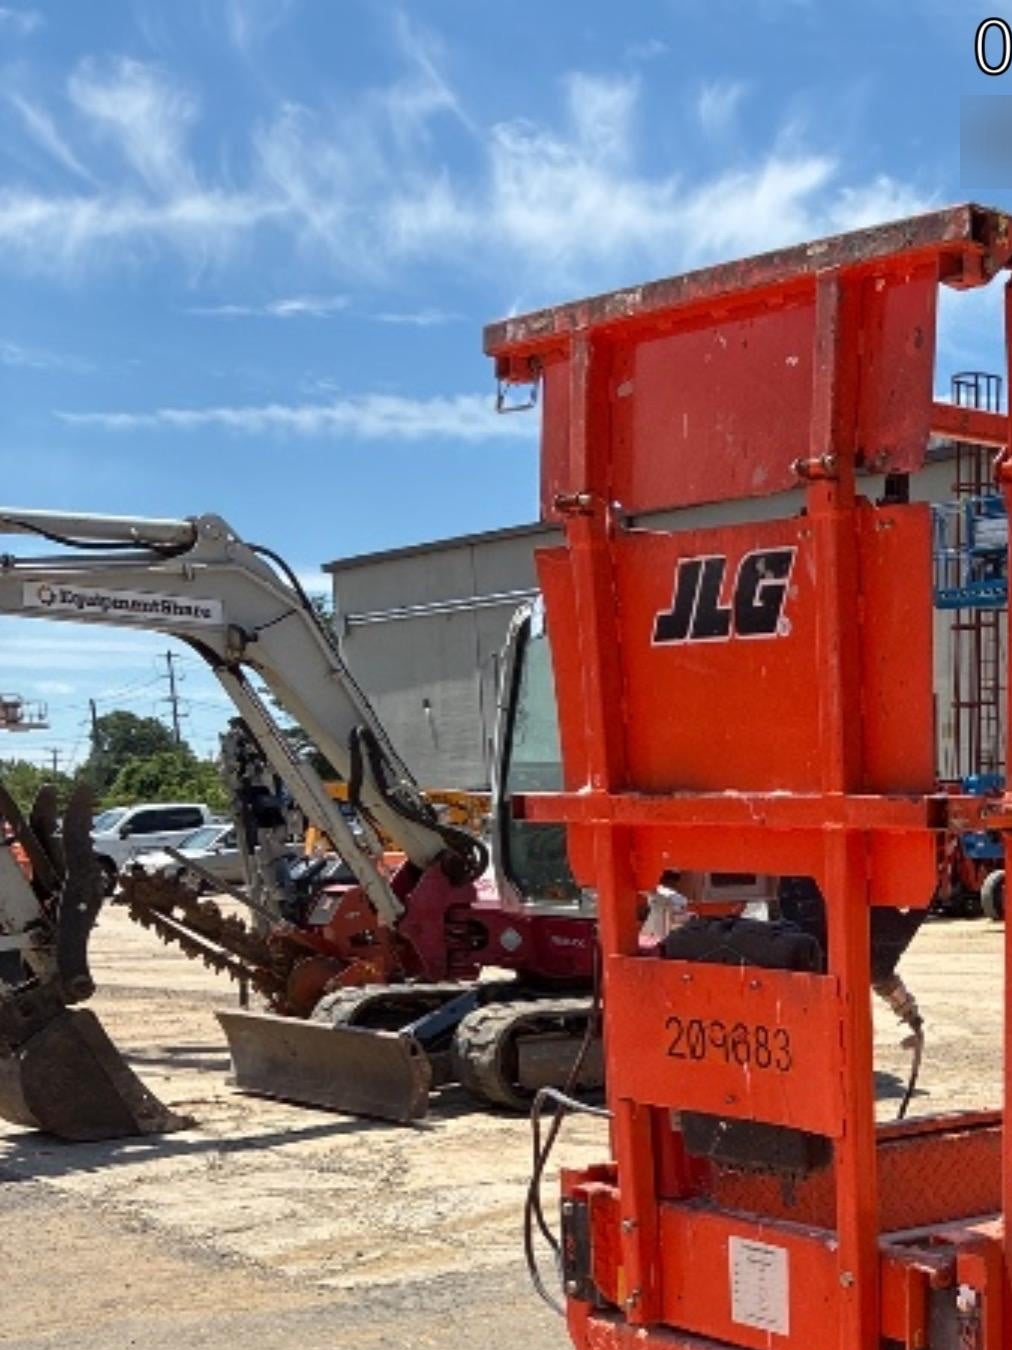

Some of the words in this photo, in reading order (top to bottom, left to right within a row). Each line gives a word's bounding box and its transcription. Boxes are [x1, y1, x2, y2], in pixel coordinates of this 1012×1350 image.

[59, 588, 212, 618] EquipmentShare
[651, 545, 799, 646] JLG
[664, 1016, 792, 1072] 209683
